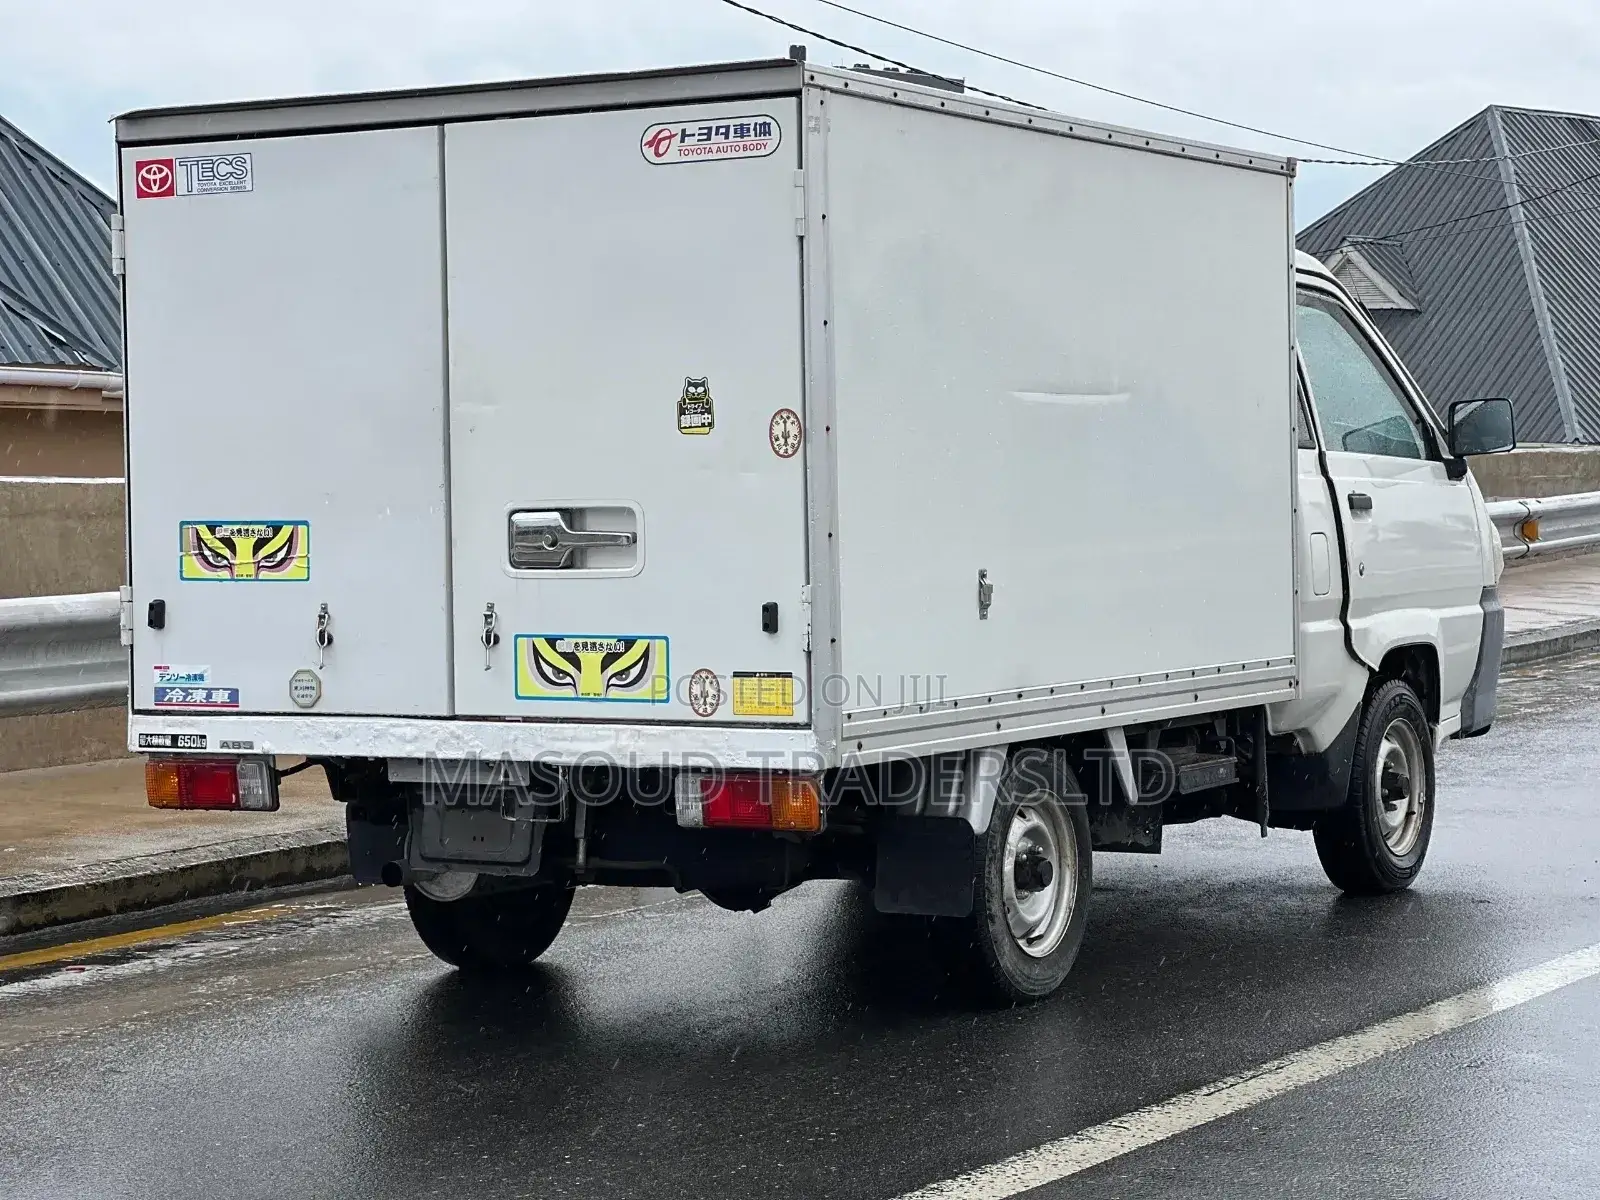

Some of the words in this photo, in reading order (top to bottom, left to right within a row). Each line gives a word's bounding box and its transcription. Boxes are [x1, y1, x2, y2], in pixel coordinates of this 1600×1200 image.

[679, 121, 772, 143] トヨタ車体
[678, 147, 714, 157] TOYOTA
[715, 144, 740, 154] AUTO
[742, 142, 769, 152] BODY
[179, 156, 248, 193] TECS
[219, 179, 247, 187] EXCELLENT
[163, 687, 232, 704] 冷凍車
[177, 735, 207, 748] 650kg
[220, 740, 254, 750] ABS
